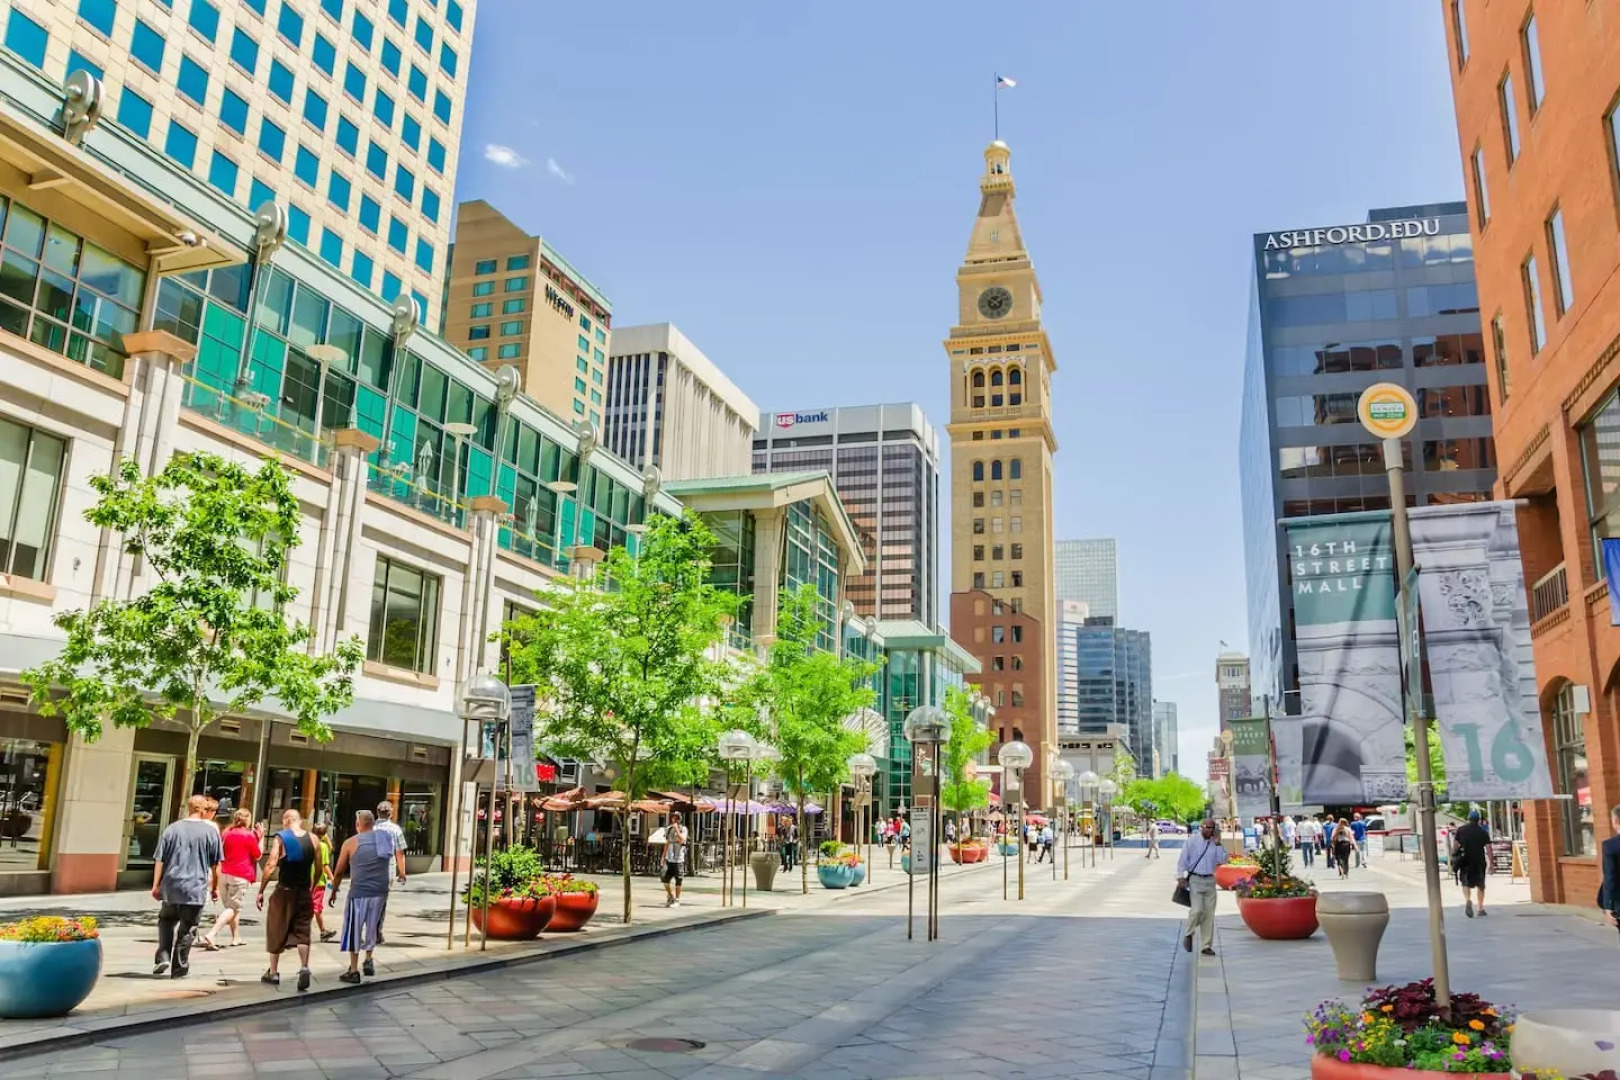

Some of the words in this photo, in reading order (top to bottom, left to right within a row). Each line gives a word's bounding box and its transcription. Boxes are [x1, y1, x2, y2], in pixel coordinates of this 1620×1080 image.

[1264, 218, 1440, 249] ASHFORD.EDU
[1295, 541, 1356, 557] 16TH
[1296, 557, 1387, 575] STREET
[1298, 577, 1362, 594] MALL
[1451, 720, 1535, 782] 16
